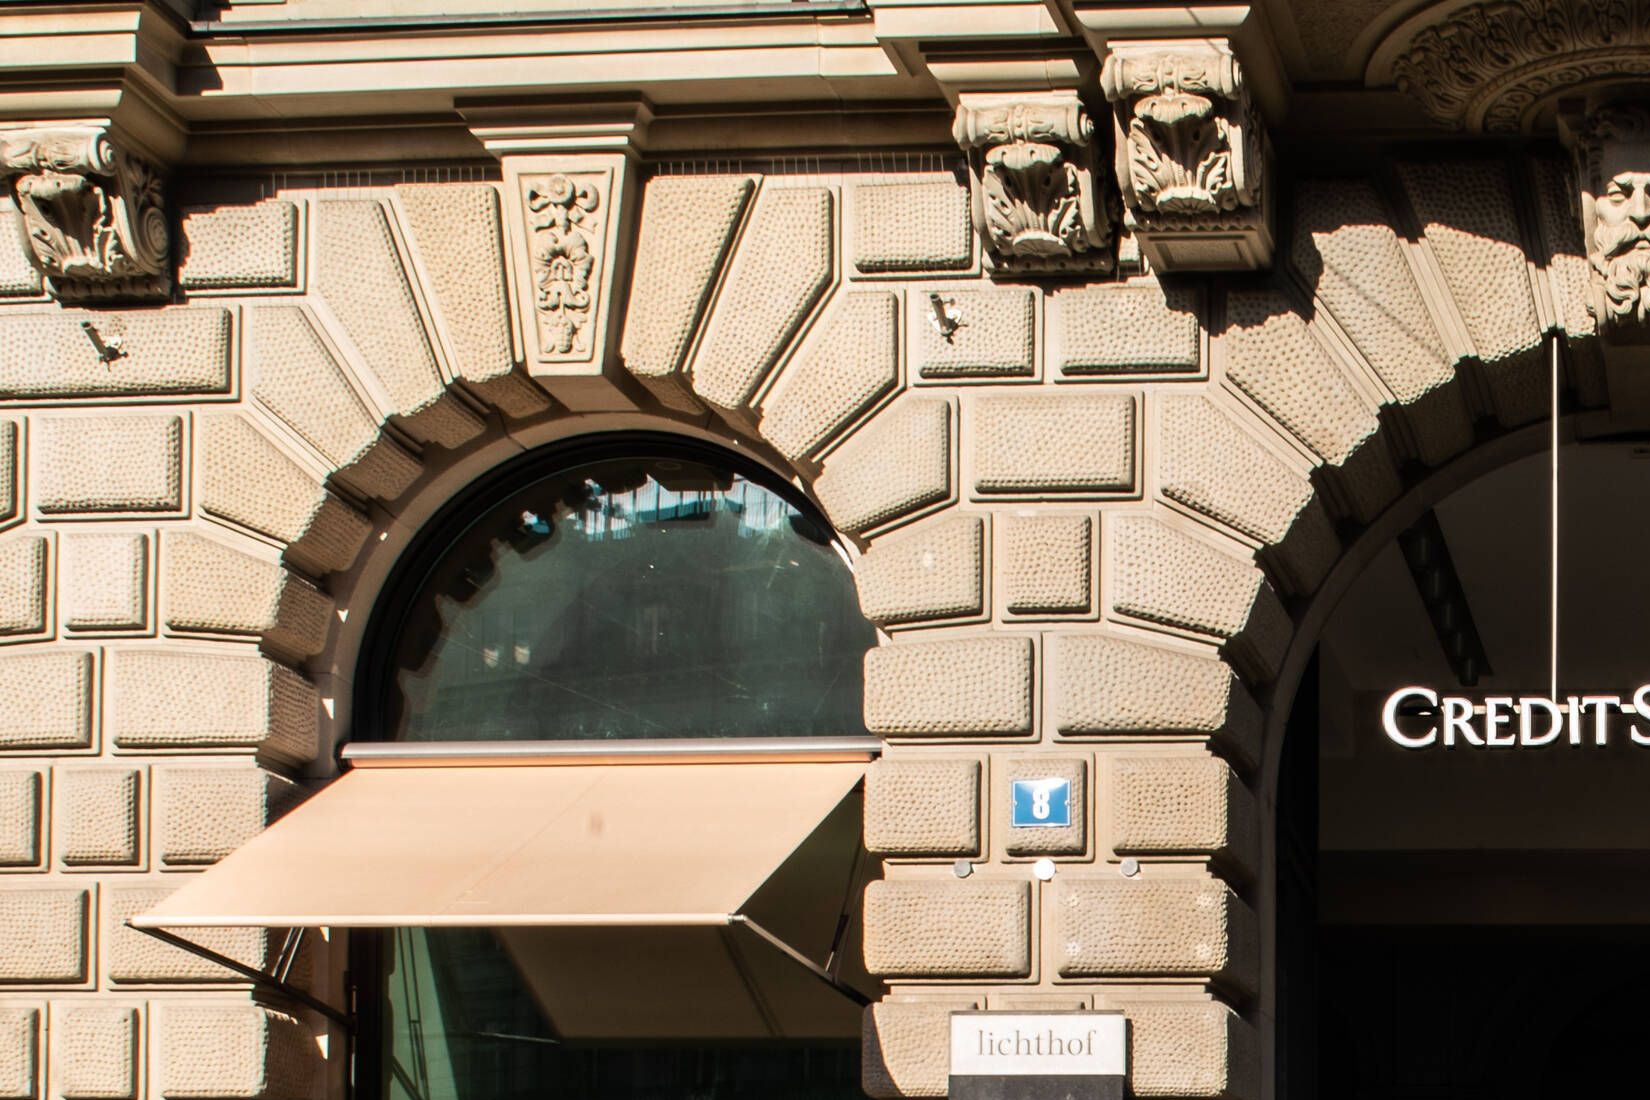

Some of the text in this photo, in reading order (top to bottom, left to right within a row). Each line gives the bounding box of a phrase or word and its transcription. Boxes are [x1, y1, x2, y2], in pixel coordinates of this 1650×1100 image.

[1382, 685, 1621, 748] CREDIT
[1032, 787, 1050, 820] 8
[977, 1029, 1097, 1057] lichthof
